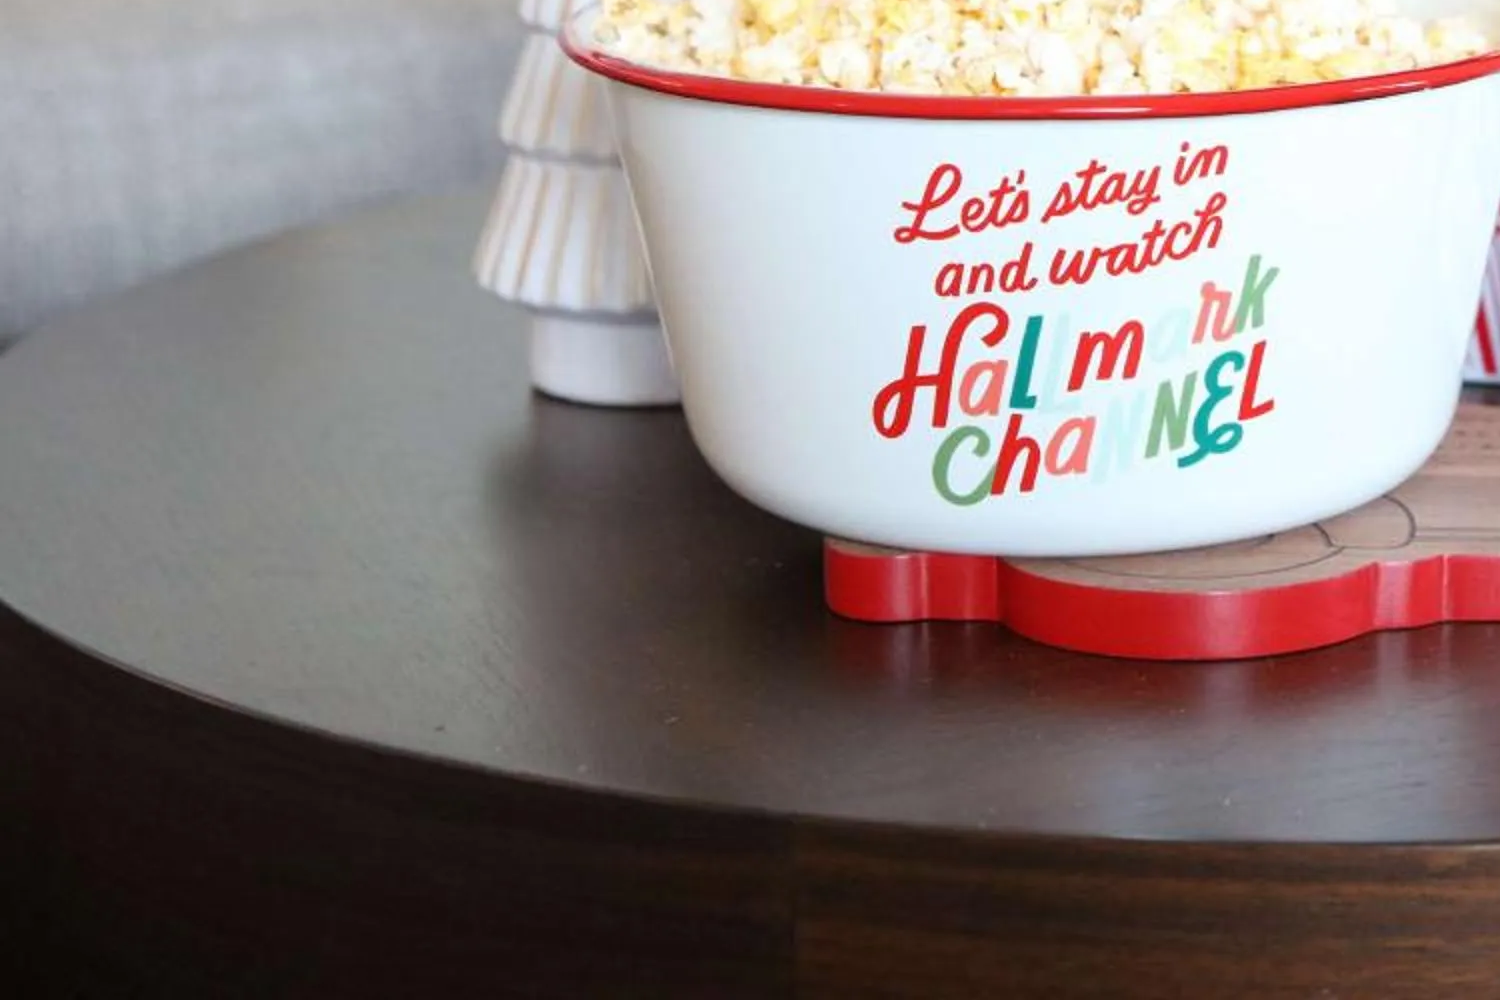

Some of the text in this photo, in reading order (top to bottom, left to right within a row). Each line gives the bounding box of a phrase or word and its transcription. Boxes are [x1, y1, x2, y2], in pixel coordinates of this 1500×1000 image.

[893, 140, 1229, 243] Let's stay in
[934, 191, 1228, 297] and watch
